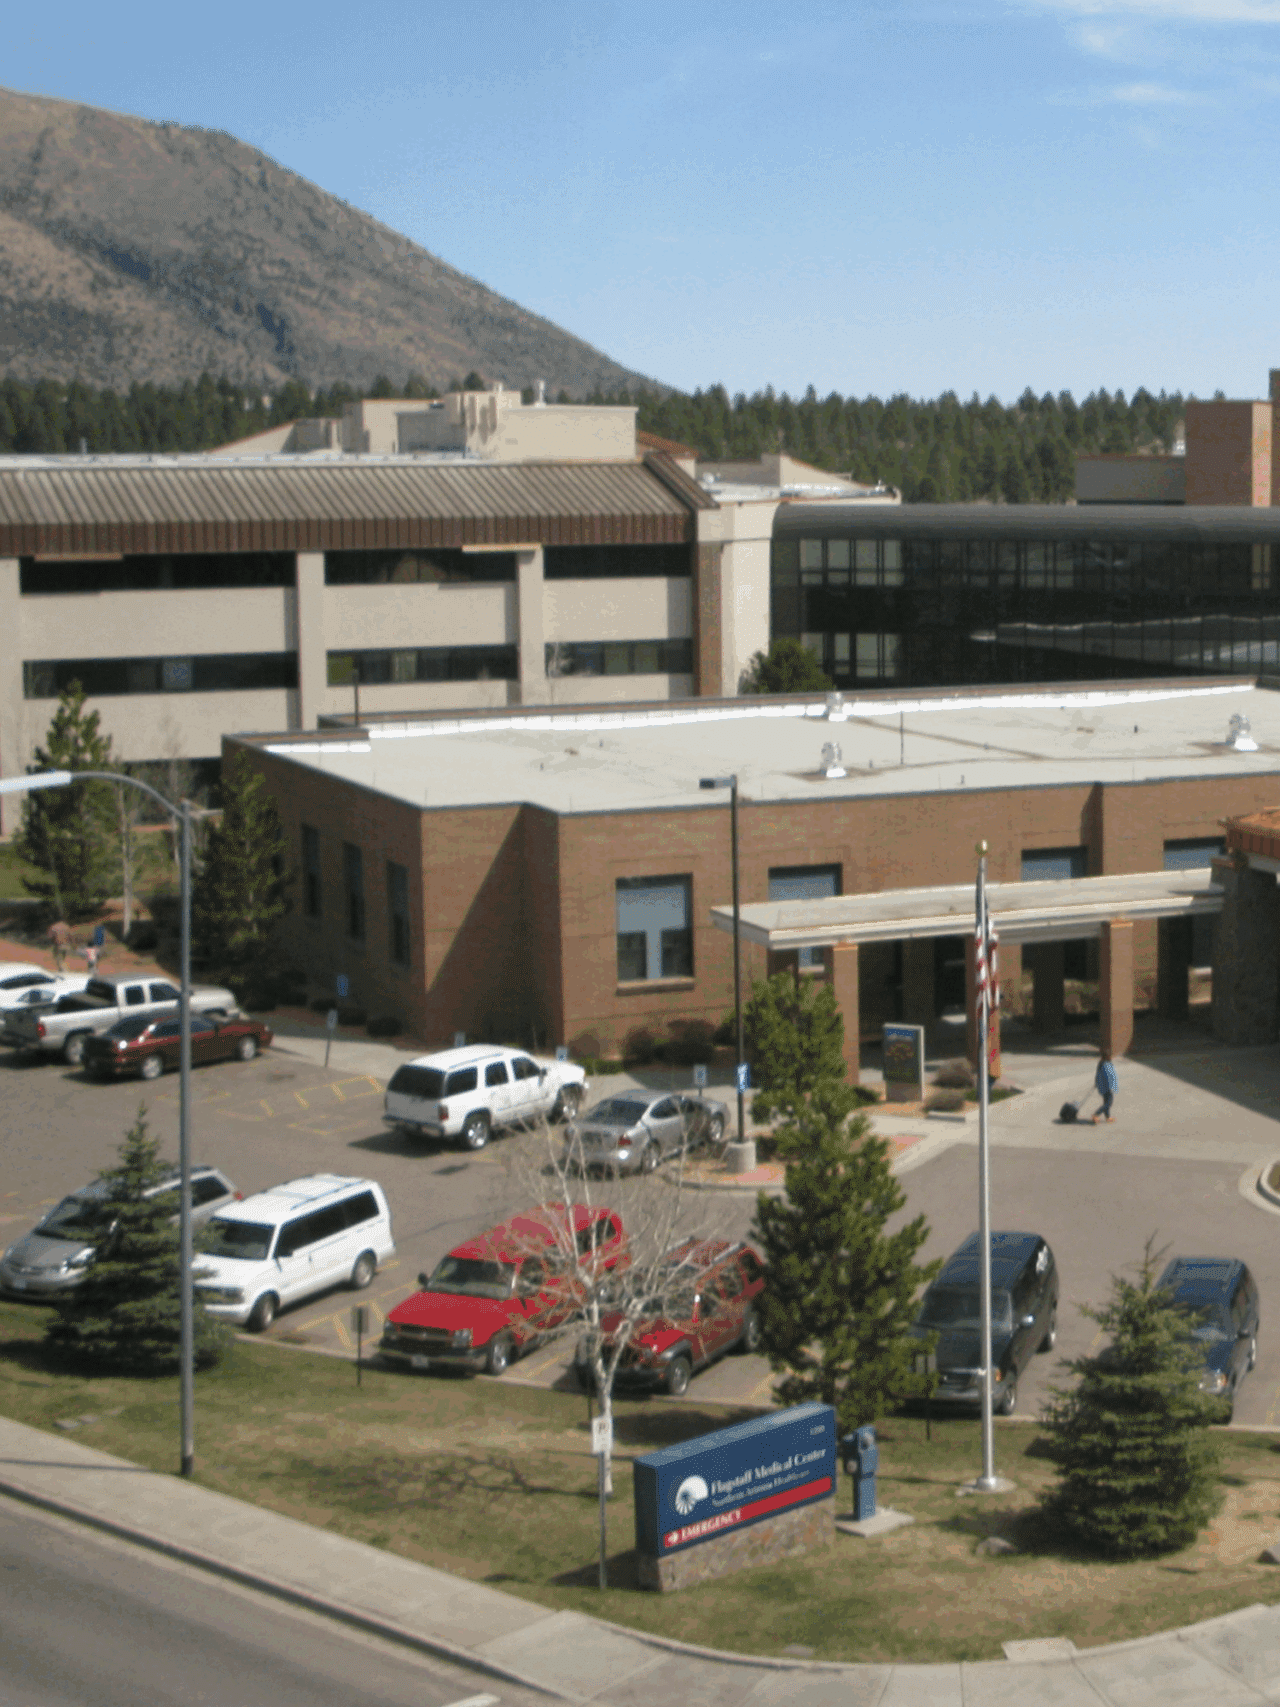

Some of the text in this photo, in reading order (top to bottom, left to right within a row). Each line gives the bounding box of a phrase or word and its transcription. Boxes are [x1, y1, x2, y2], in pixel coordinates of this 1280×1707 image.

[711, 1449, 826, 1495] Flagstaff Medical Center
[681, 1510, 741, 1539] EMERGENCY
